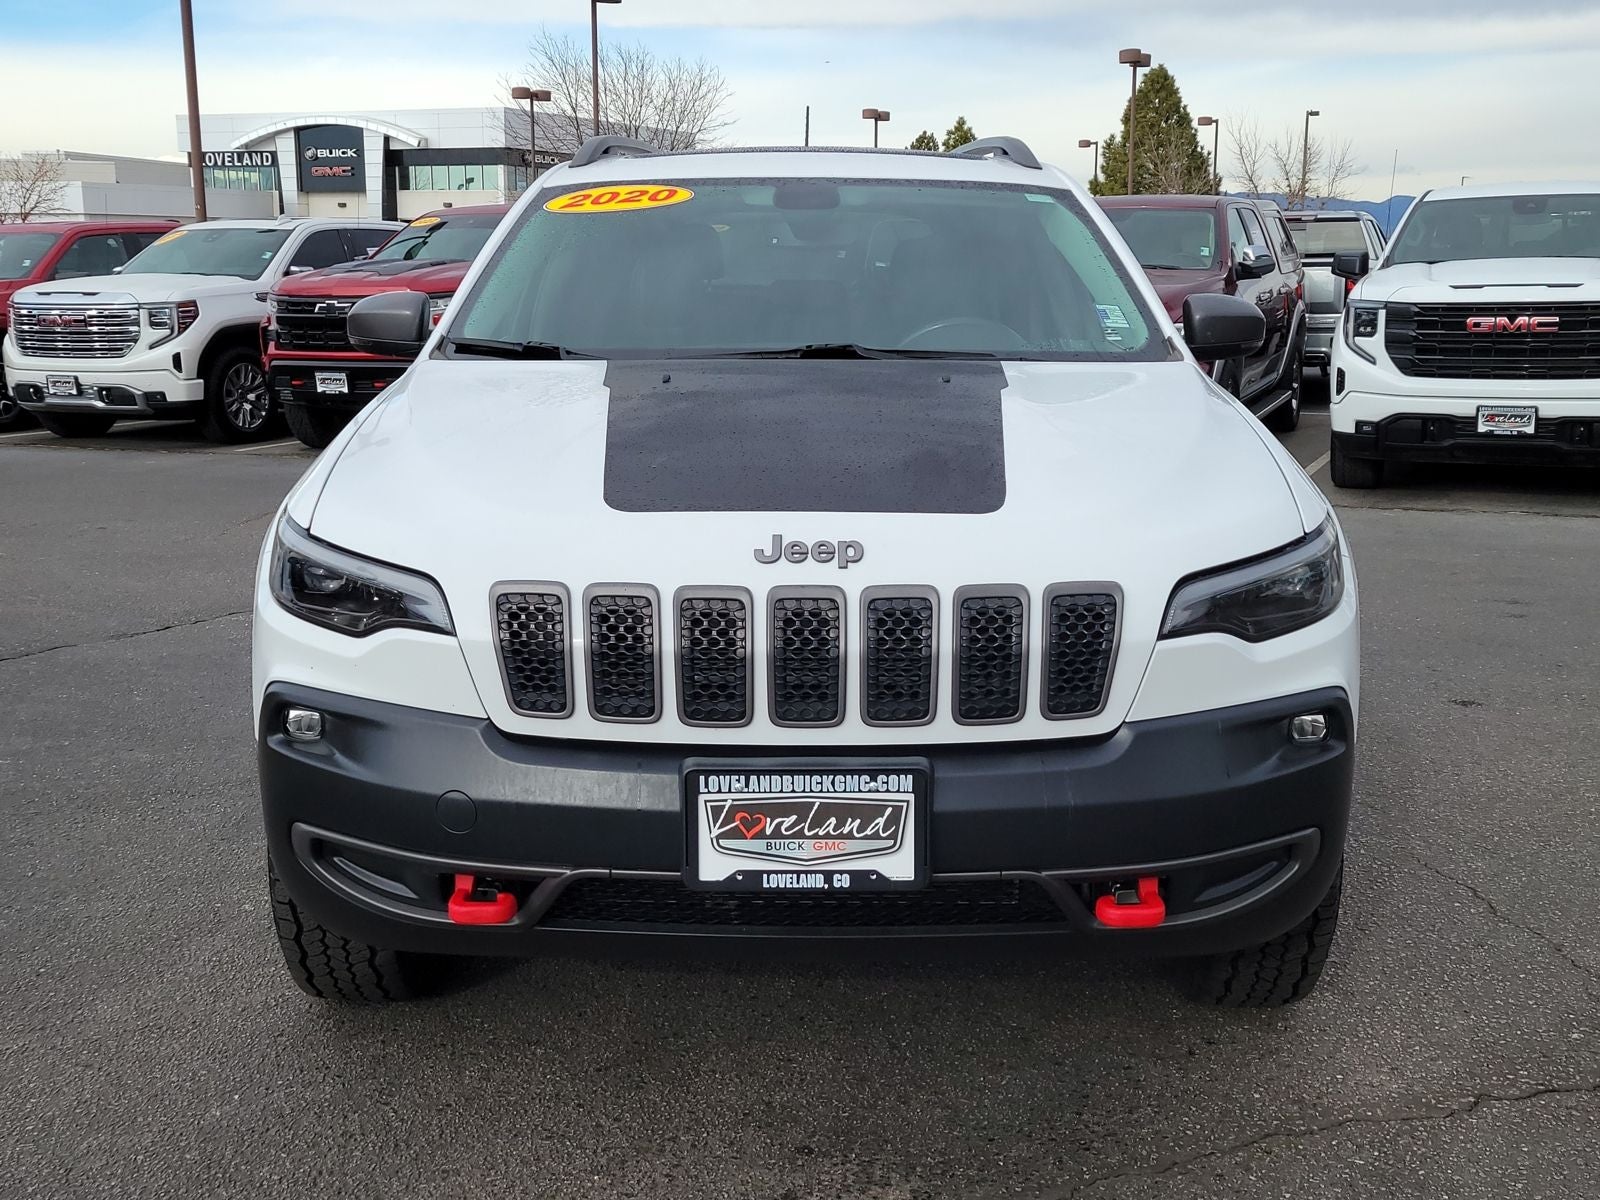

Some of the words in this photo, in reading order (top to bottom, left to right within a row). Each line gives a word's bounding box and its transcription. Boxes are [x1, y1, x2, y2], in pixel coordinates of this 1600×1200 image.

[202, 152, 272, 166] OVELAND
[317, 148, 358, 158] BUICK
[311, 166, 352, 177] GMC
[558, 188, 678, 209] 2020
[38, 315, 85, 327] GMC
[1466, 316, 1559, 333] GMC
[754, 534, 864, 569] Jeep
[699, 774, 913, 792] LOVELANDBUICKGMCCOM
[766, 840, 806, 851] BUICK
[812, 840, 848, 851] GMC
[762, 873, 829, 889] LOVELAND,
[833, 873, 850, 888] CO
